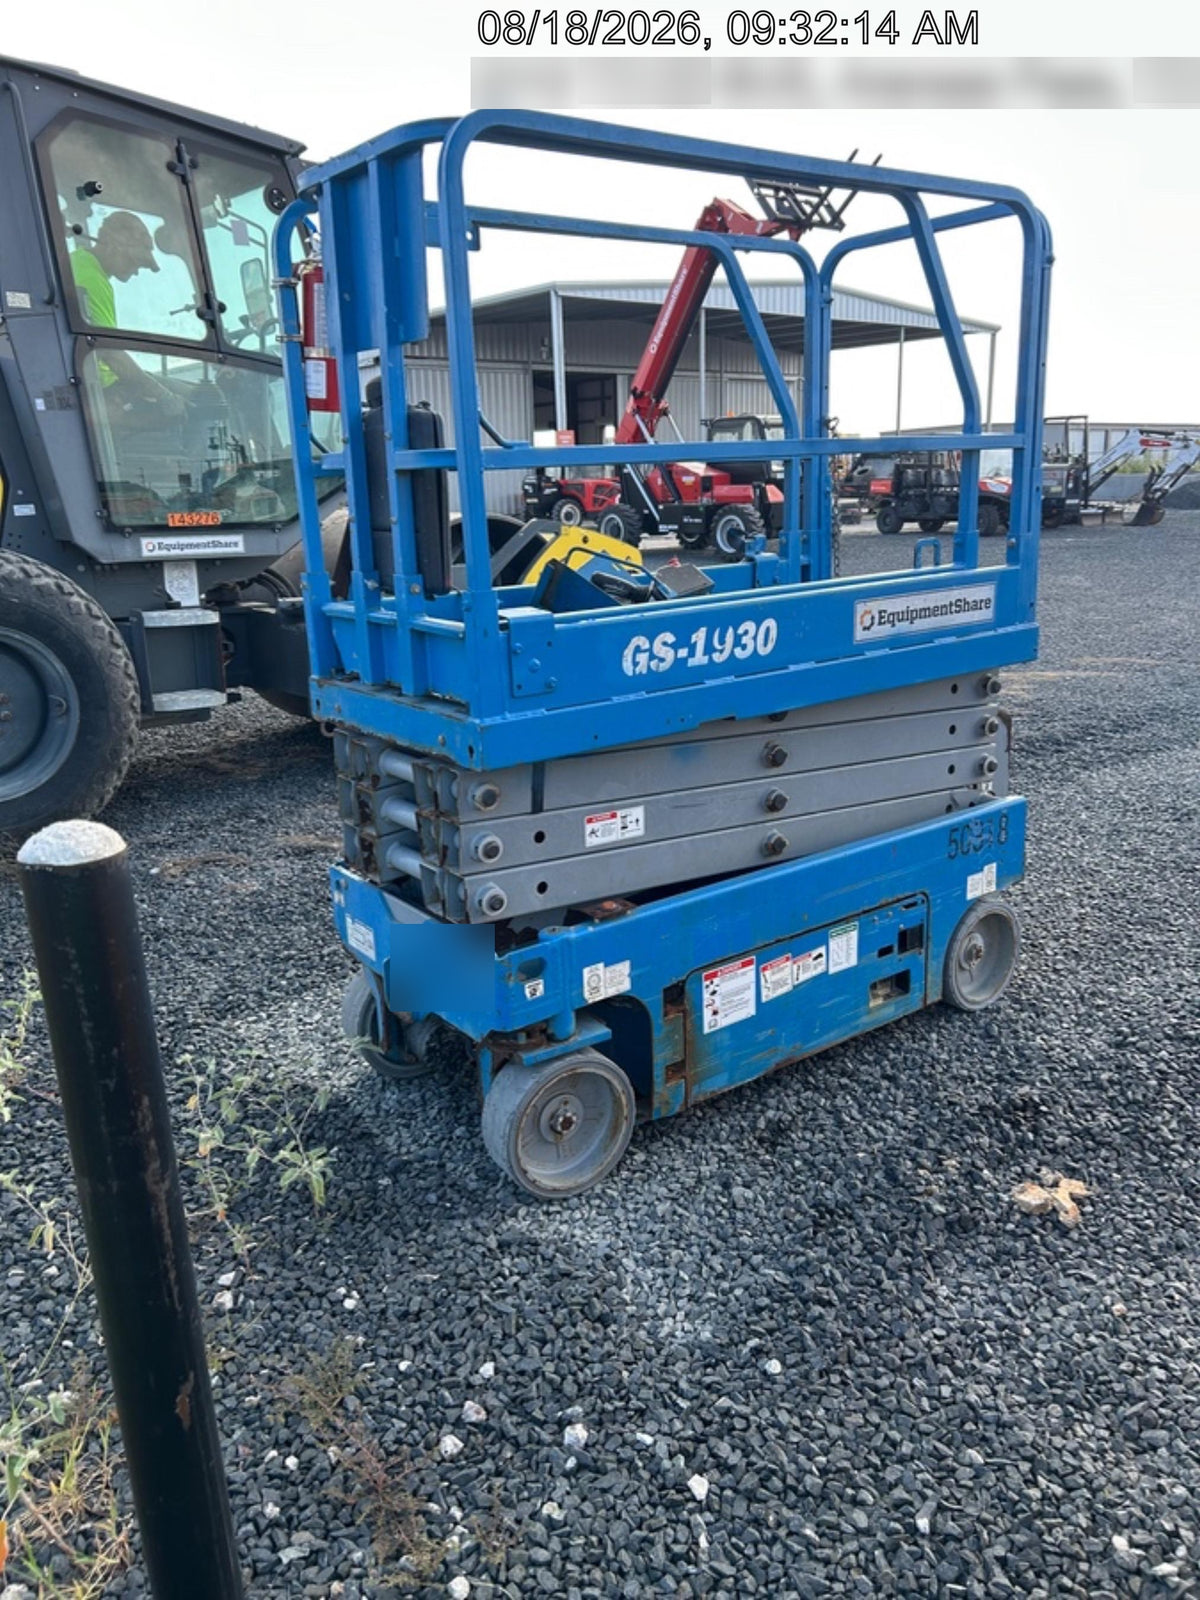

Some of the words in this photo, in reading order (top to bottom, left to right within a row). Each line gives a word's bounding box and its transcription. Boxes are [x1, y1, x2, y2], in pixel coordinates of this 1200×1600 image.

[170, 512, 219, 525] 143276
[157, 540, 239, 551] EquipmentShare
[877, 597, 992, 628] EquipmentShare
[622, 617, 778, 676] GS-1930
